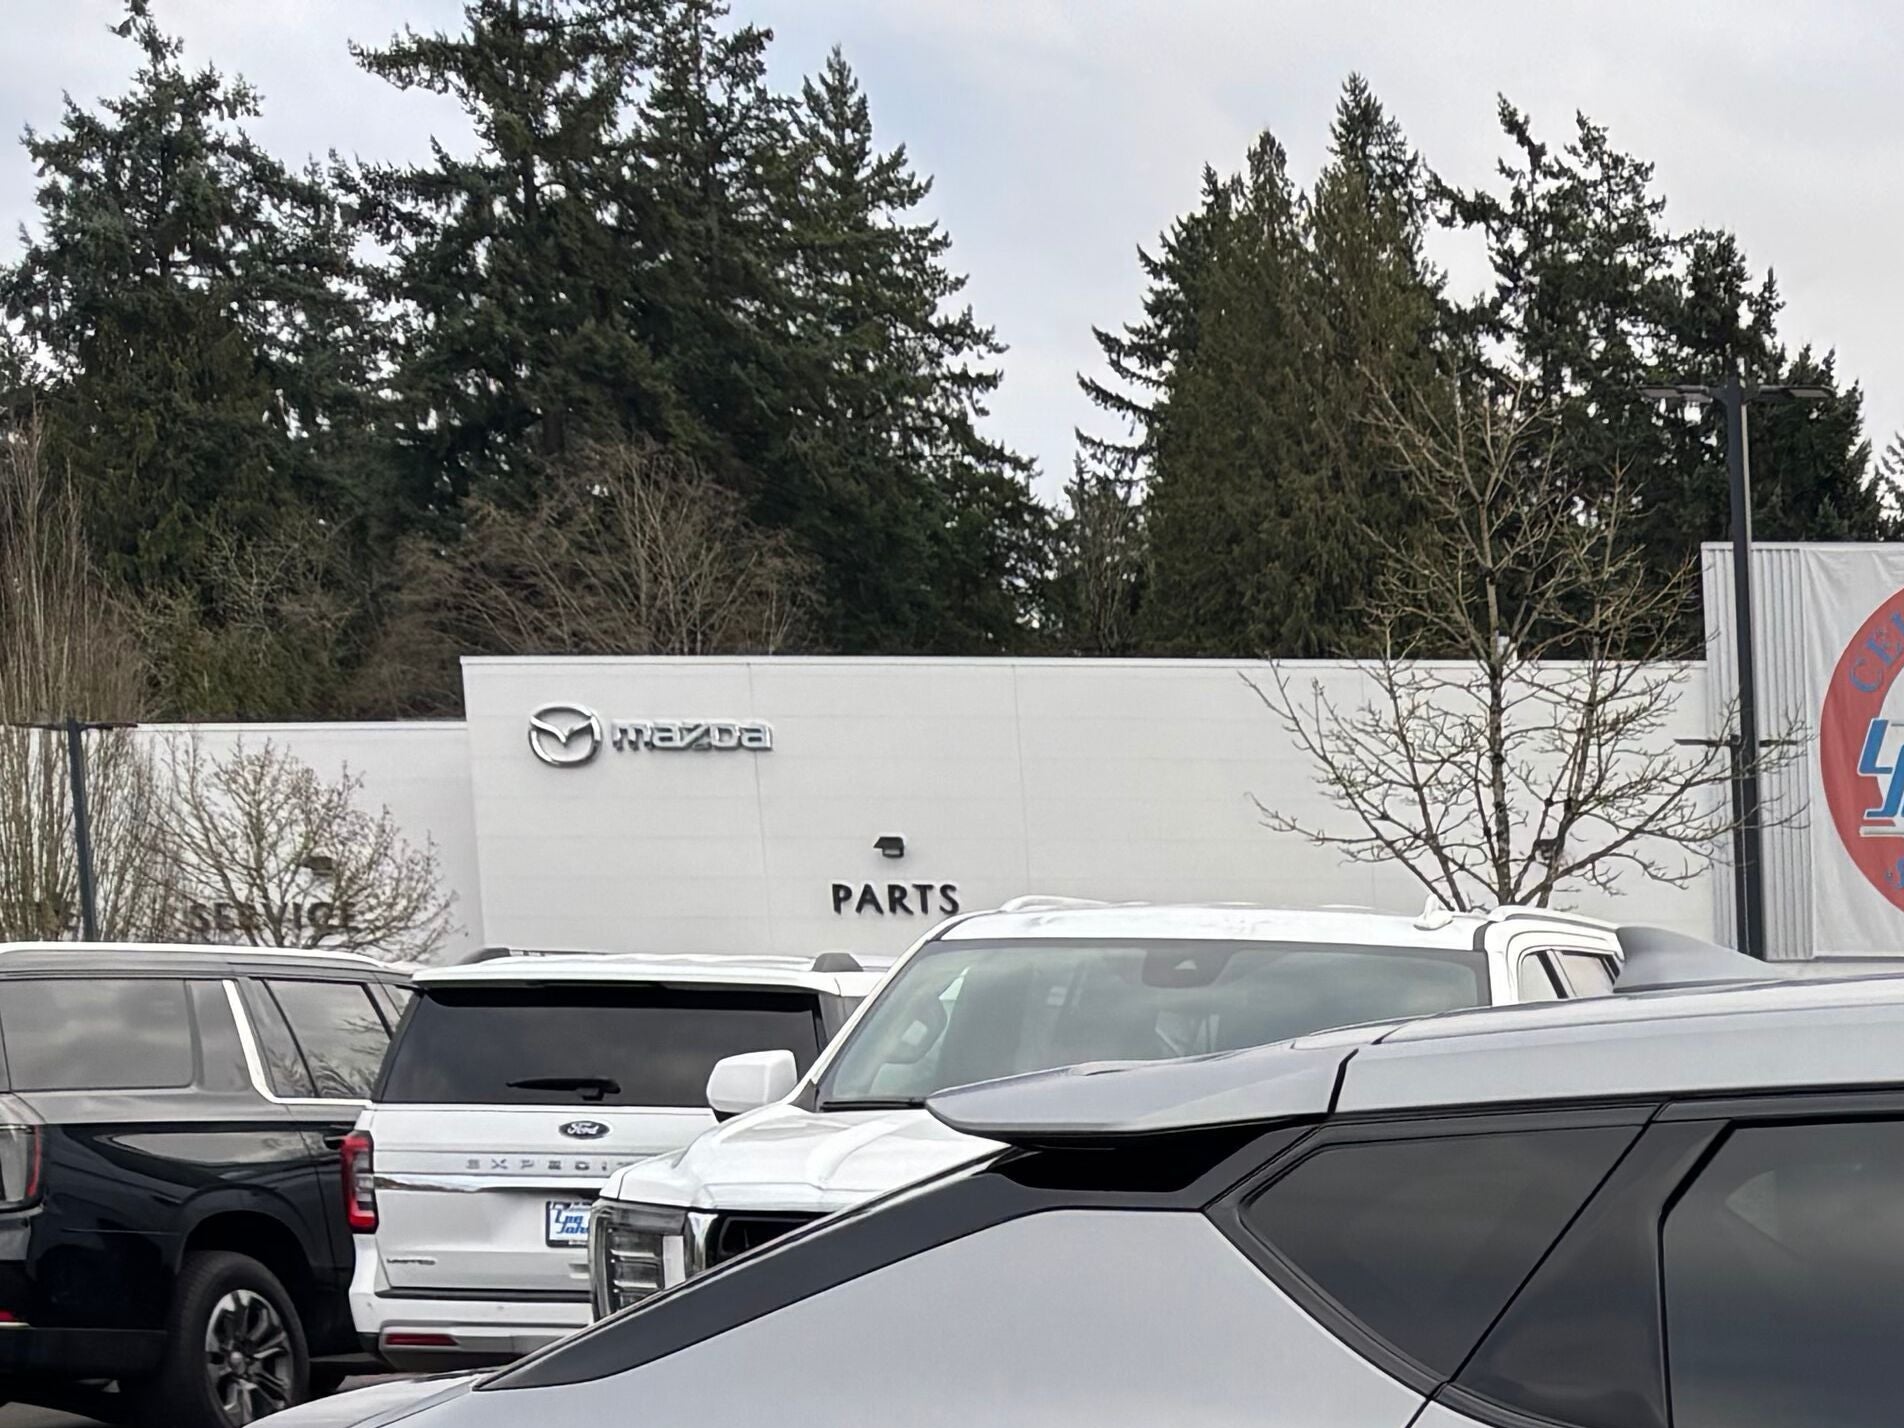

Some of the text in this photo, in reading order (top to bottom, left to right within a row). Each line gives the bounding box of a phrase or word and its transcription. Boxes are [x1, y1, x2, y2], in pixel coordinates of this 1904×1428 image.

[611, 719, 774, 752] mazda
[832, 883, 960, 915] PARTS
[566, 1122, 599, 1136] Ford
[465, 1158, 634, 1172] EXPEDI
